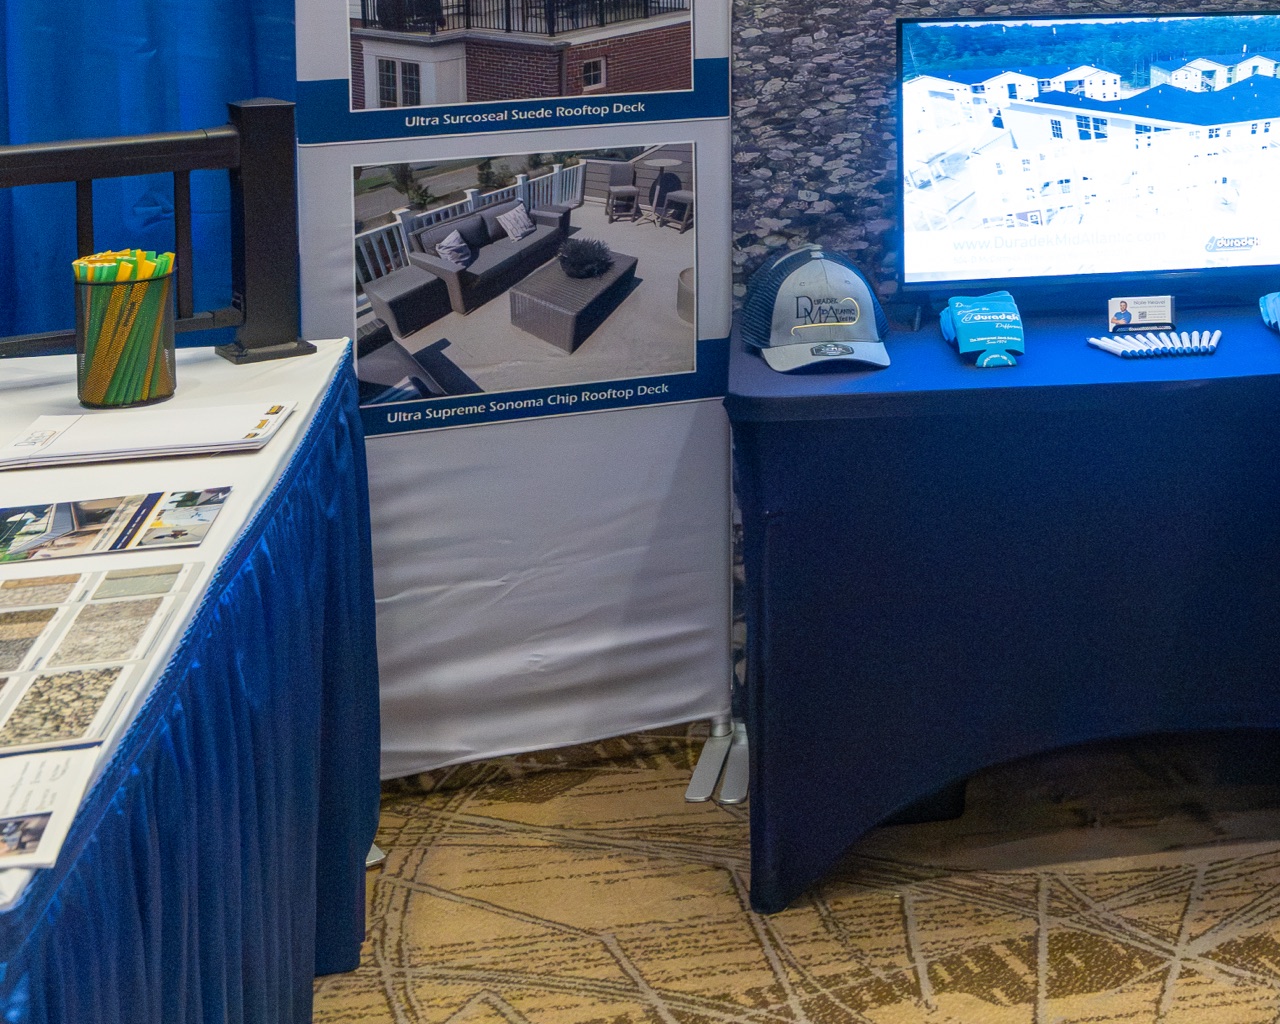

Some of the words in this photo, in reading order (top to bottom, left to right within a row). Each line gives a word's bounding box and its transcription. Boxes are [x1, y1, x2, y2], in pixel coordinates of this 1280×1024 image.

[405, 115, 440, 127] Ultra
[443, 109, 508, 125] Surcoseal
[511, 108, 553, 120] Suede
[556, 105, 609, 117] Rooftop
[613, 102, 645, 114] Deck
[387, 410, 422, 424] Ultra
[425, 403, 485, 420] Supreme
[489, 396, 543, 412] Sonoma
[547, 393, 578, 406] Chip
[581, 387, 634, 402] Rooftop
[637, 383, 669, 396] Deck
